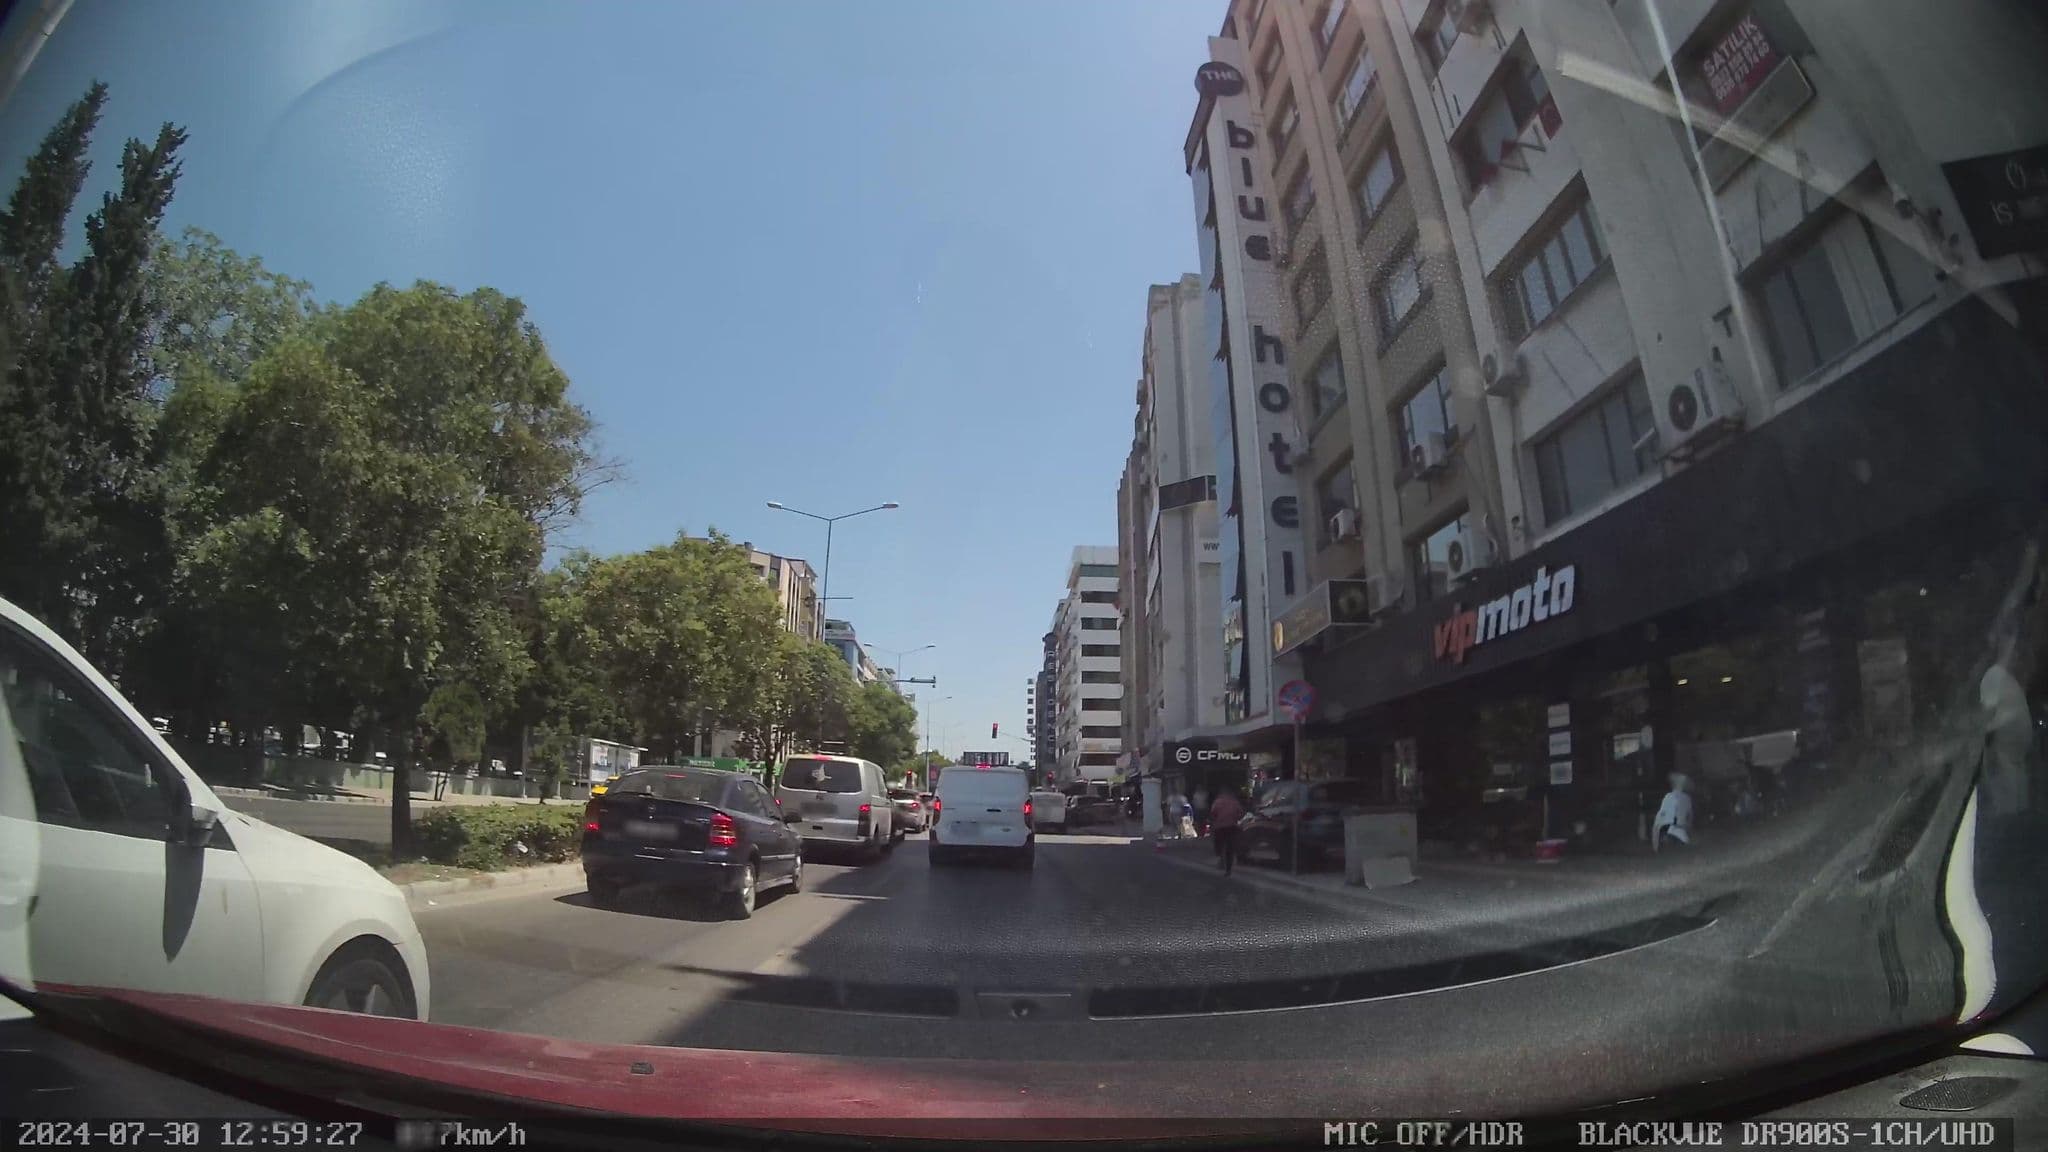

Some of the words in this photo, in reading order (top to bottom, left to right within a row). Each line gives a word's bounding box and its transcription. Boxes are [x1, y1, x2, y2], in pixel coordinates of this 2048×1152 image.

[1202, 69, 1239, 82] THE
[1703, 16, 1758, 77] SATILIK
[1227, 119, 1272, 262] blue
[1254, 324, 1300, 597] hotel
